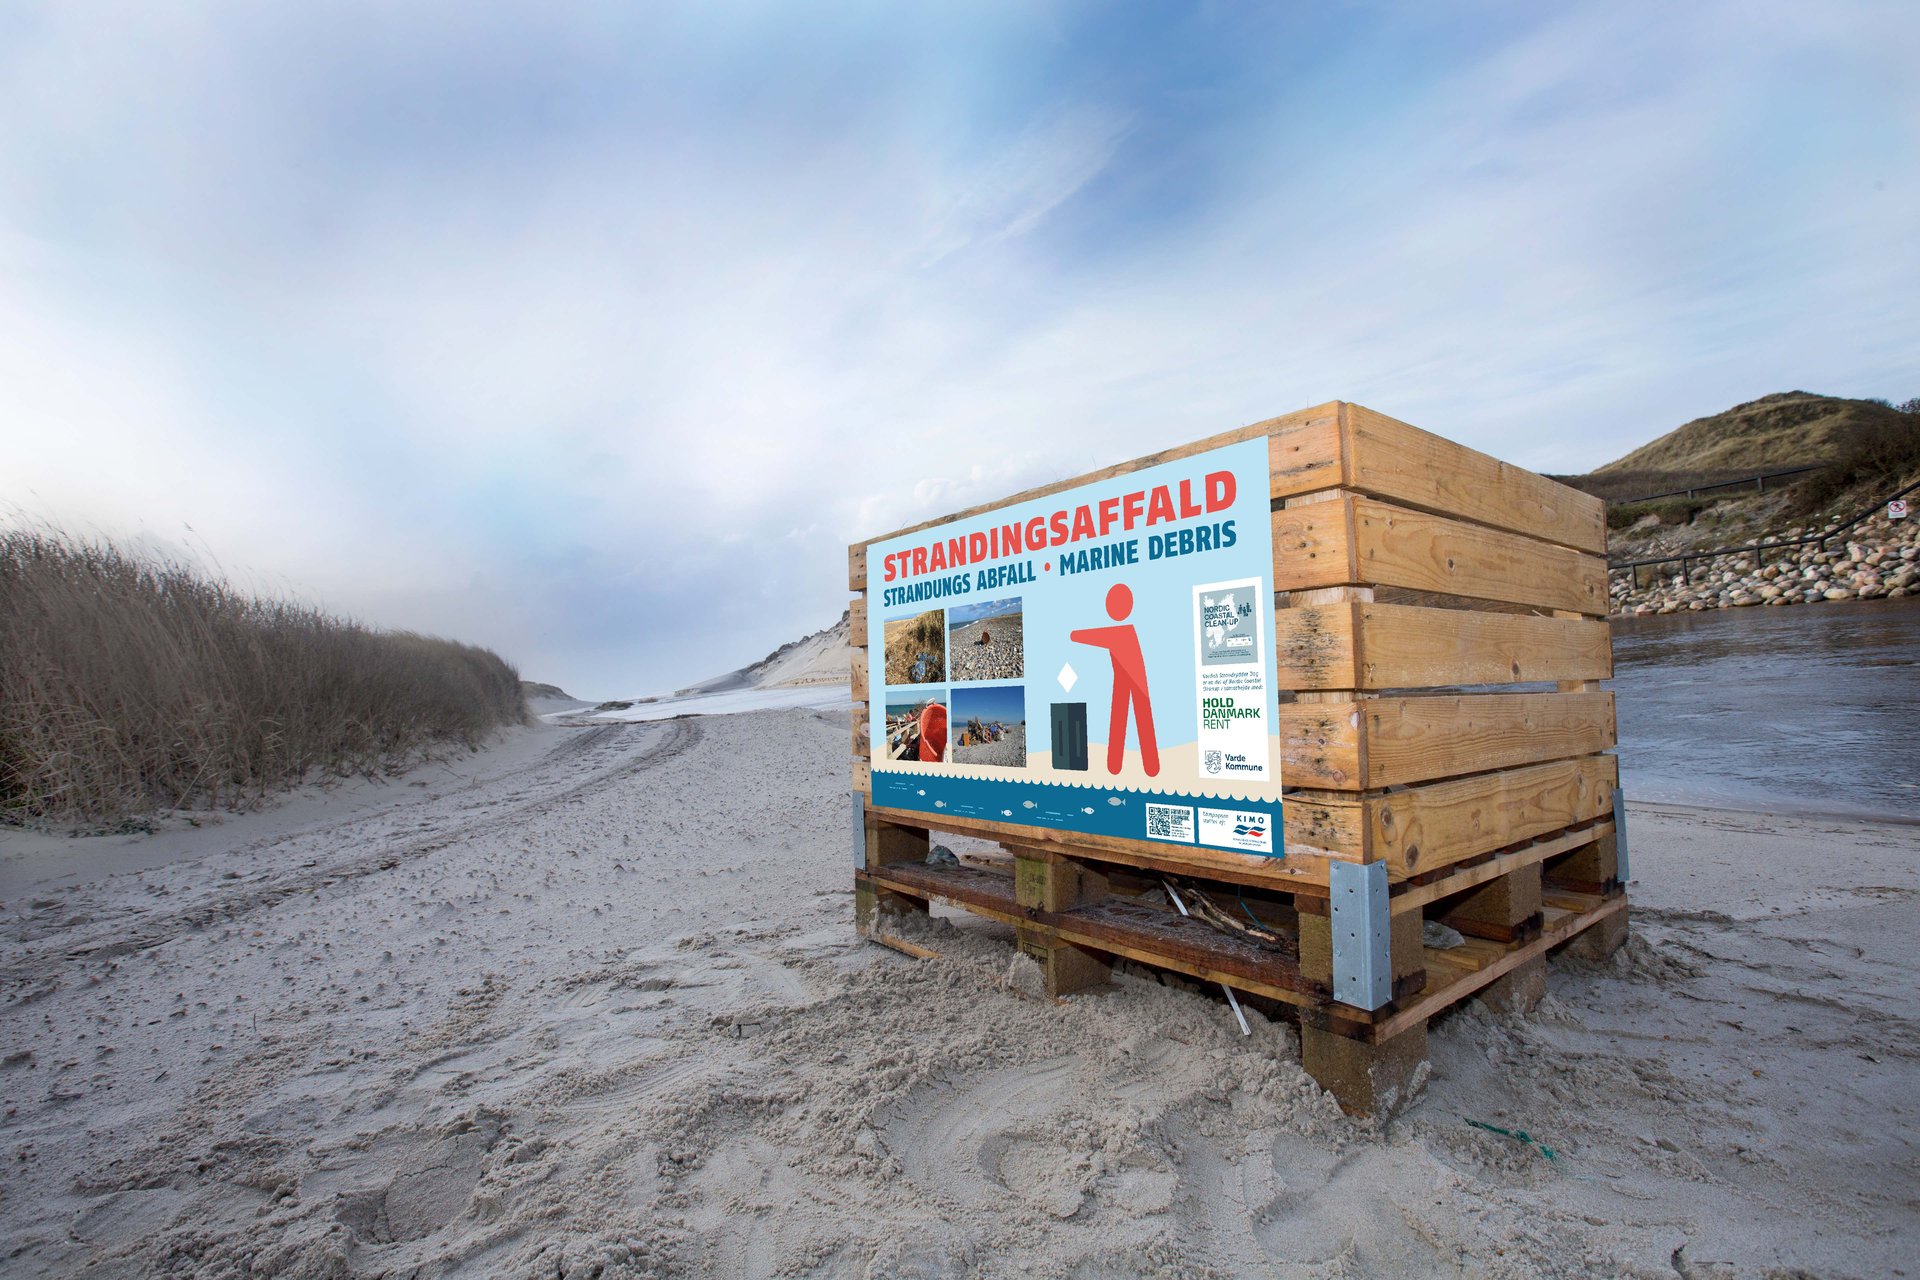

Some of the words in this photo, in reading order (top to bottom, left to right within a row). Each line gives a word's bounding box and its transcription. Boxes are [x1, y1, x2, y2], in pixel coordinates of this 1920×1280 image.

[884, 470, 1237, 582] STRANDINGSAFFALD
[884, 573, 971, 607] STRANDUNGS
[977, 561, 1036, 591] ABFALL
[1060, 540, 1138, 576] MARINE
[1149, 520, 1237, 561] DEBRIS
[1204, 605, 1230, 613] NORDIC
[1204, 612, 1235, 620] COASTAL
[1204, 618, 1239, 627] CLEAN-UP
[1203, 698, 1234, 708] HOLD
[1203, 708, 1261, 719] DANMARK
[1203, 719, 1231, 730] RENT
[1225, 754, 1246, 762] Varde
[1225, 762, 1263, 771] Kommune
[1236, 814, 1265, 824] KIMO
